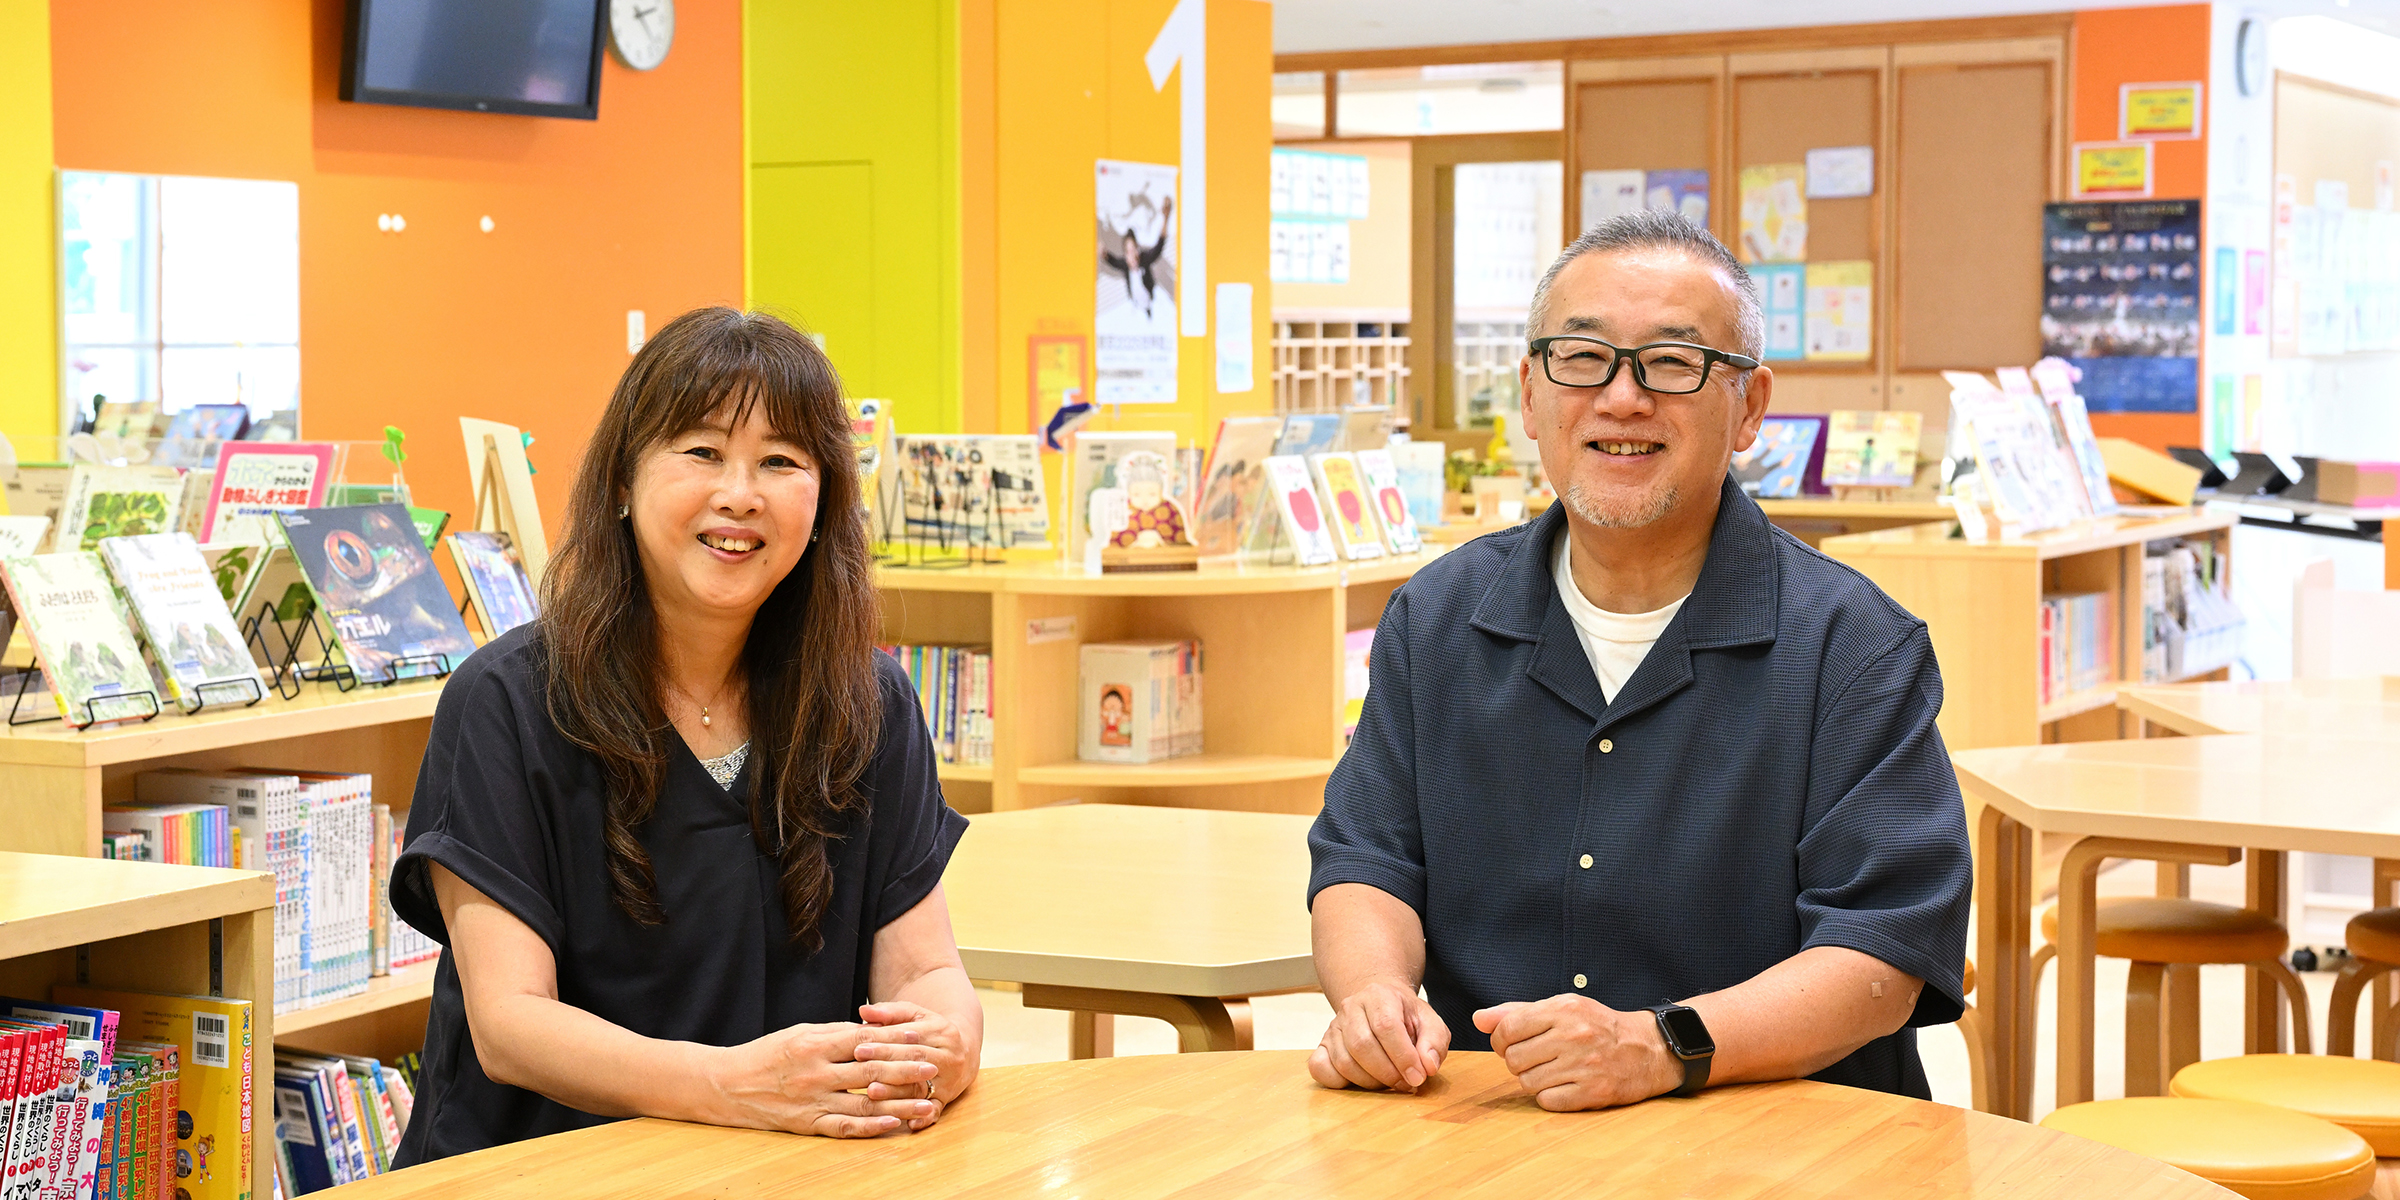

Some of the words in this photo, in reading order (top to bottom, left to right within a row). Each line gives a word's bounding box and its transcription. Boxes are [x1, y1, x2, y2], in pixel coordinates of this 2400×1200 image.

[1145, 0, 1206, 336] 1
[138, 570, 160, 580] Frog
[162, 568, 178, 577] and
[336, 613, 391, 641] カエル
[6, 1047, 21, 1096] 現地取材!
[24, 1045, 37, 1093] 現地取材!
[36, 1043, 48, 1091] 現地取材!
[51, 1037, 65, 1086] 現地取材!
[62, 1060, 79, 1068] もっと
[241, 1033, 252, 1133] こども日本地図
[11, 1103, 27, 1160] 世界のくらし
[23, 1100, 39, 1157] 世界のくらし
[40, 1094, 55, 1151] 世界のくらし
[66, 1097, 88, 1175] 行ってみよう!
[100, 1101, 117, 1165] 47都道府県
[119, 1096, 134, 1158] 47都道府県
[135, 1091, 150, 1153] 47都道府県
[149, 1085, 163, 1147] 47都道府県
[166, 1082, 180, 1145] 47都道府県
[48, 1104, 70, 1184] 行ってみよう!
